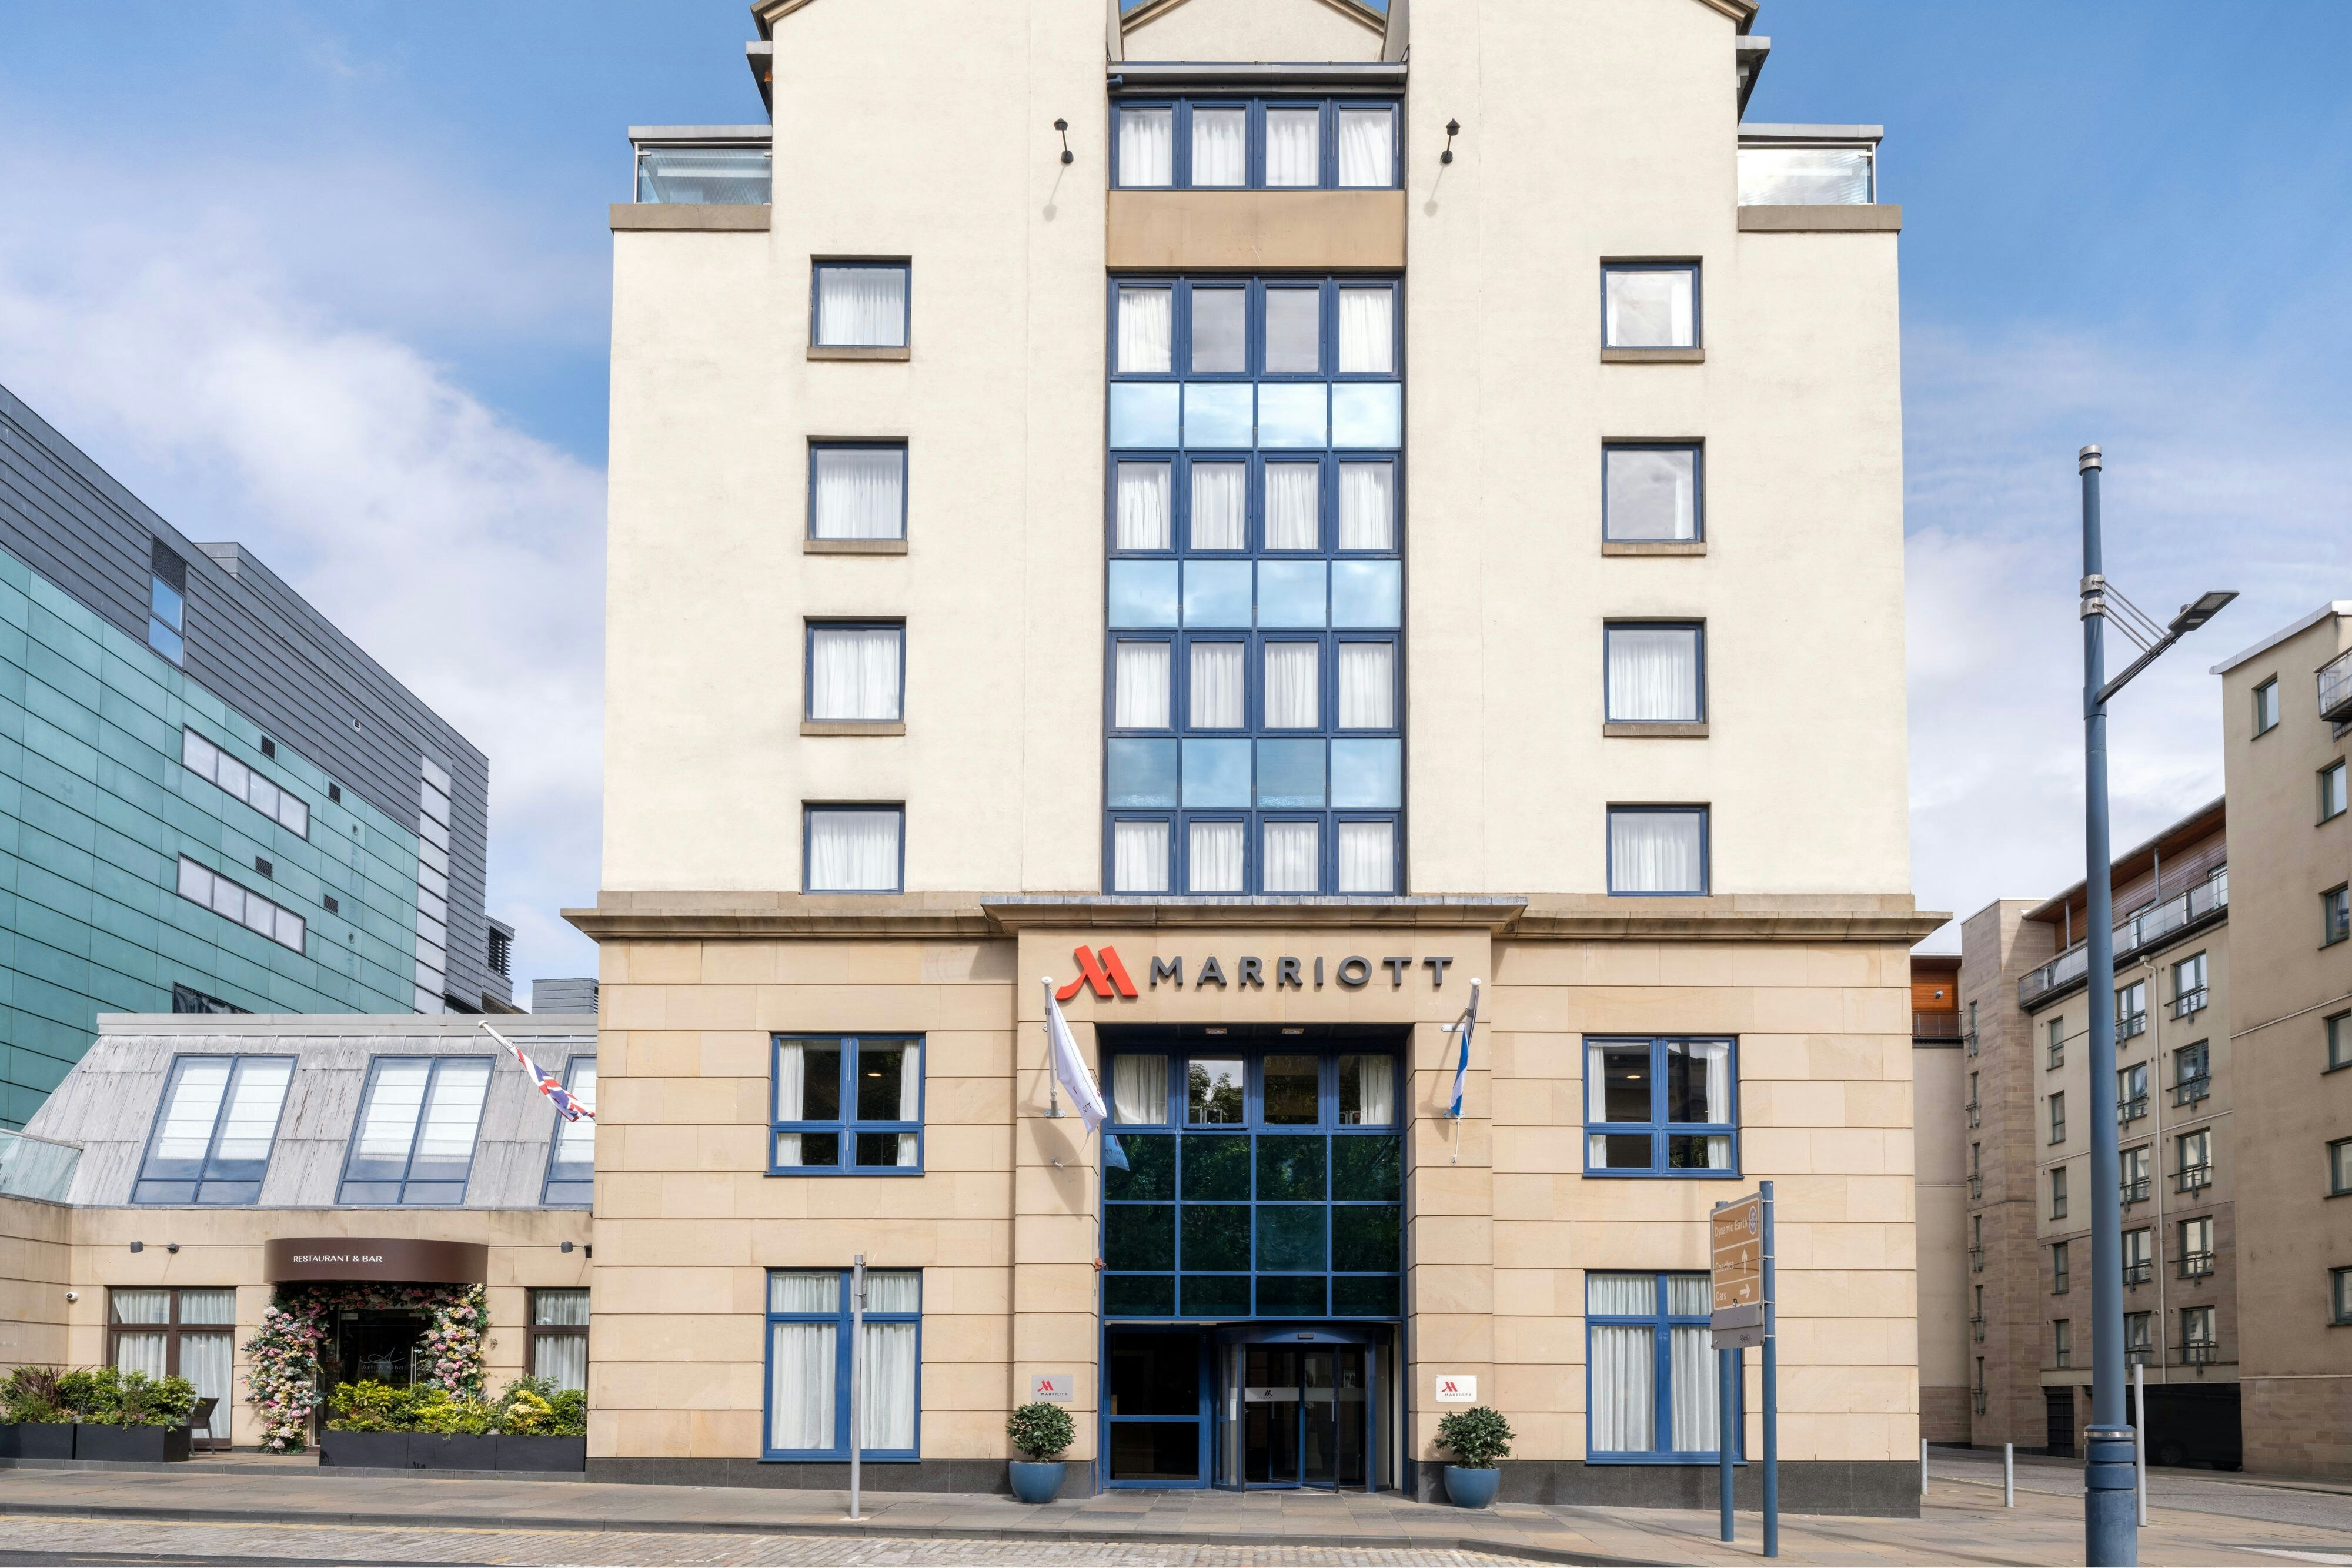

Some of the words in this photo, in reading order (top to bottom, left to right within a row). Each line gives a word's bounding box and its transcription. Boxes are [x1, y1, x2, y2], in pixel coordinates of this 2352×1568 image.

[1150, 955, 1454, 985] MARRIOTT
[1715, 1223, 1733, 1238] Dynamic
[1735, 1217, 1748, 1231] Earth
[1715, 1261, 1735, 1273] Coaches
[1716, 1290, 1726, 1301] Cars
